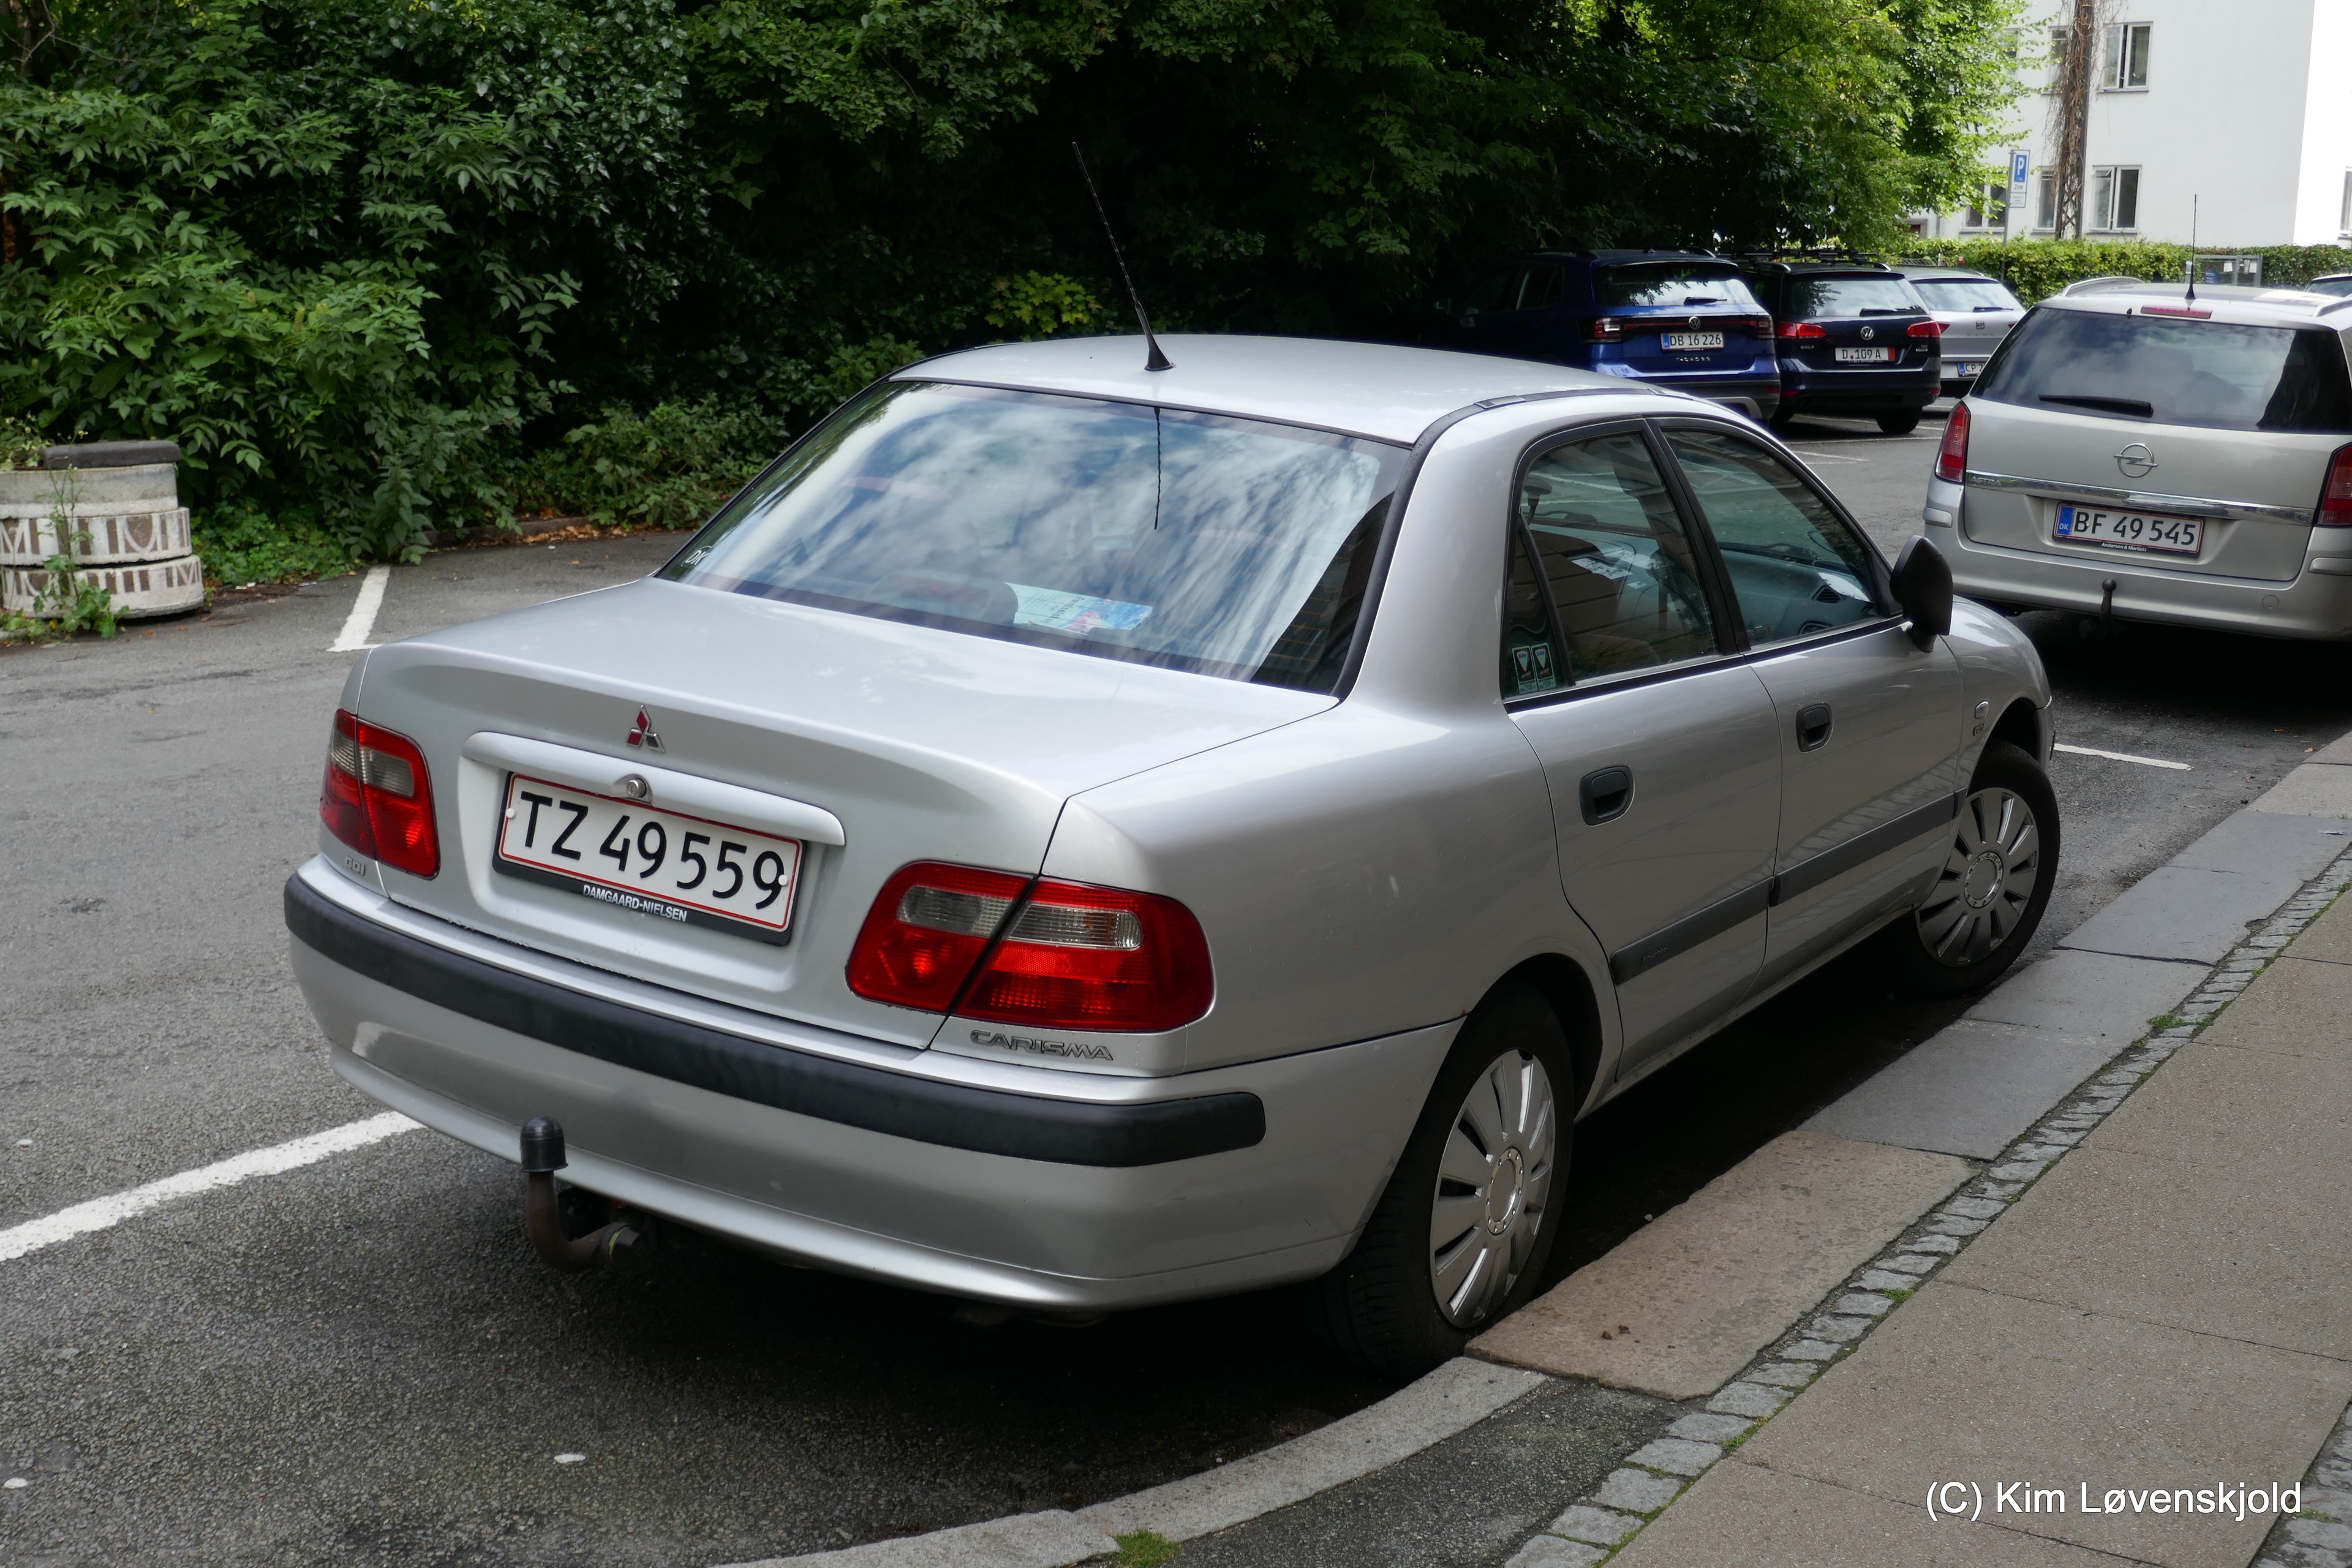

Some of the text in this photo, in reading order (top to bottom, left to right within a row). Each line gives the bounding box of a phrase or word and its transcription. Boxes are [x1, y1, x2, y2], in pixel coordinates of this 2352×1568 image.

[2017, 157, 2025, 176] P
[1670, 334, 1722, 346] DB 16 226
[1965, 363, 1977, 372] CP
[1970, 476, 2002, 486] ASTRA
[2059, 522, 2070, 531] DK
[2074, 511, 2196, 546] BF 49 545
[684, 549, 710, 566] DK
[519, 791, 786, 910] TZ 49 559
[582, 884, 688, 922] DAMGAARD-NIELSEN
[970, 1029, 1114, 1061] CARISMA
